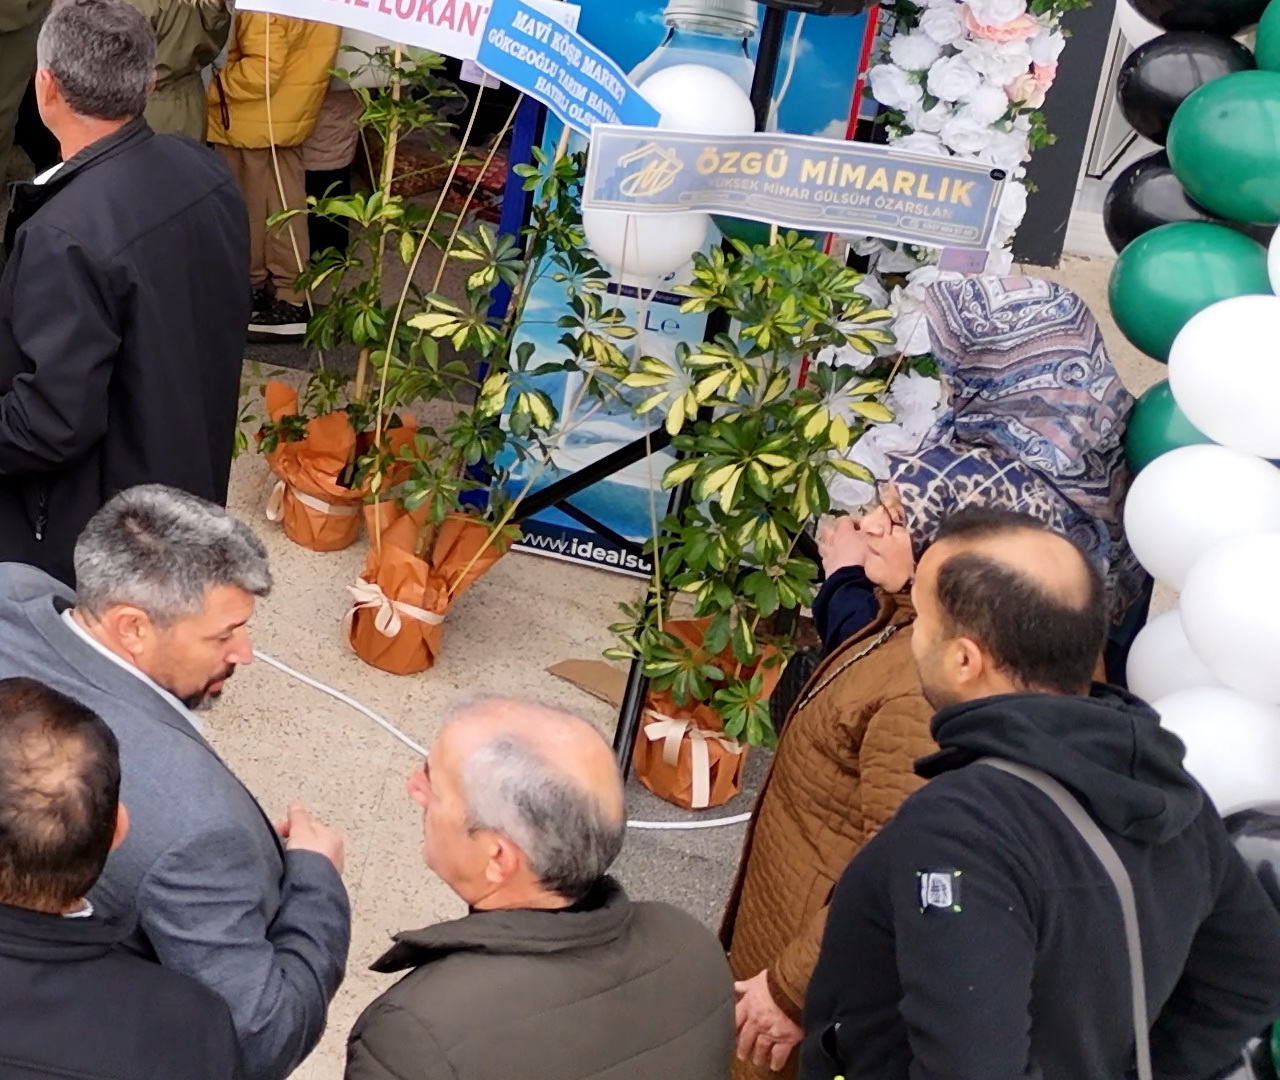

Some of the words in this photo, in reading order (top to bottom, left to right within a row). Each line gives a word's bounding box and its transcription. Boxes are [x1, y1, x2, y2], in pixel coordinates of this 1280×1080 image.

[511, 9, 553, 44] MAVİ
[550, 31, 582, 69] KÖŞE
[580, 55, 626, 106] MARKET
[534, 76, 570, 112] HAYIRLI
[558, 68, 588, 102] TARIM
[695, 146, 788, 180] ÖZGÜ
[799, 156, 976, 208] MİMARLIK
[709, 176, 759, 191] YÜKSEK
[763, 182, 810, 201] MİMAR
[814, 188, 871, 207] GÜLSÜM
[874, 195, 954, 220] ÖZARSLAN
